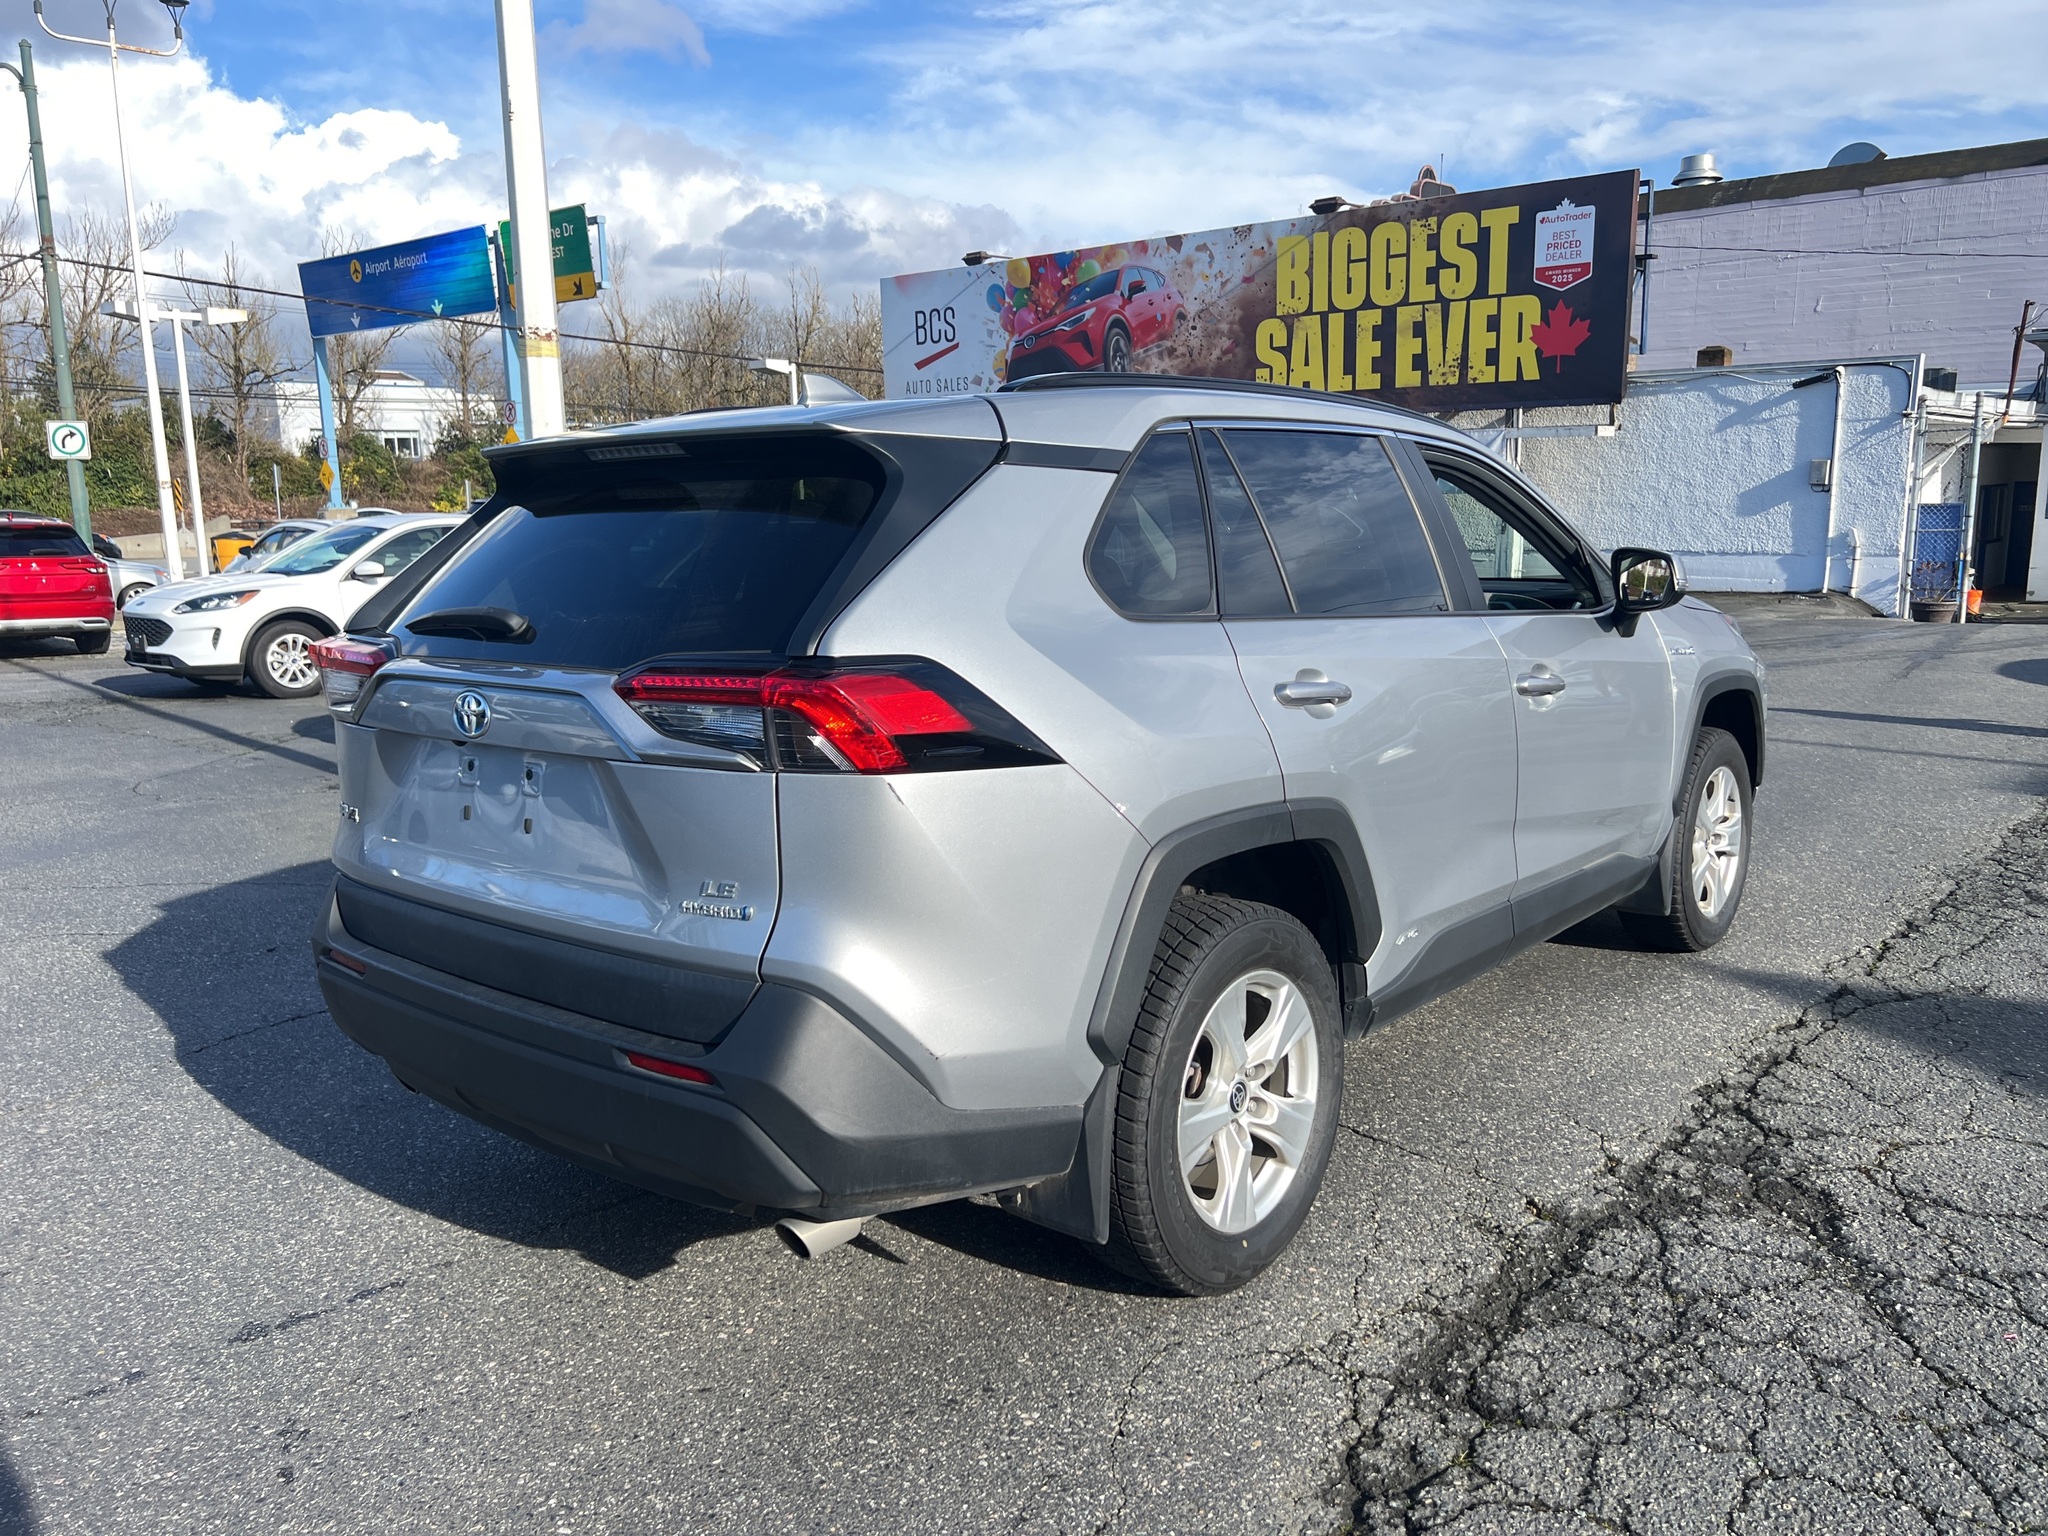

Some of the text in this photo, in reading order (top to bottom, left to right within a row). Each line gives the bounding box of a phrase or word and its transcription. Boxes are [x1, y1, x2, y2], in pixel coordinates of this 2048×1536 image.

[1544, 212, 1592, 224] AutoTrader
[562, 222, 574, 237] Dr
[1552, 230, 1577, 241] BEST
[1546, 240, 1582, 252] PRICED
[365, 252, 428, 276] Airport Aéroport
[1276, 205, 1520, 316] BIGGEST
[1545, 250, 1582, 262] DEALER
[1551, 274, 1573, 283] 2025
[914, 306, 956, 346] BCS
[1255, 294, 1542, 392] SALE EVER
[905, 376, 969, 395] AUTO SALES
[699, 880, 739, 899] LE
[680, 900, 742, 920] HYBRID
